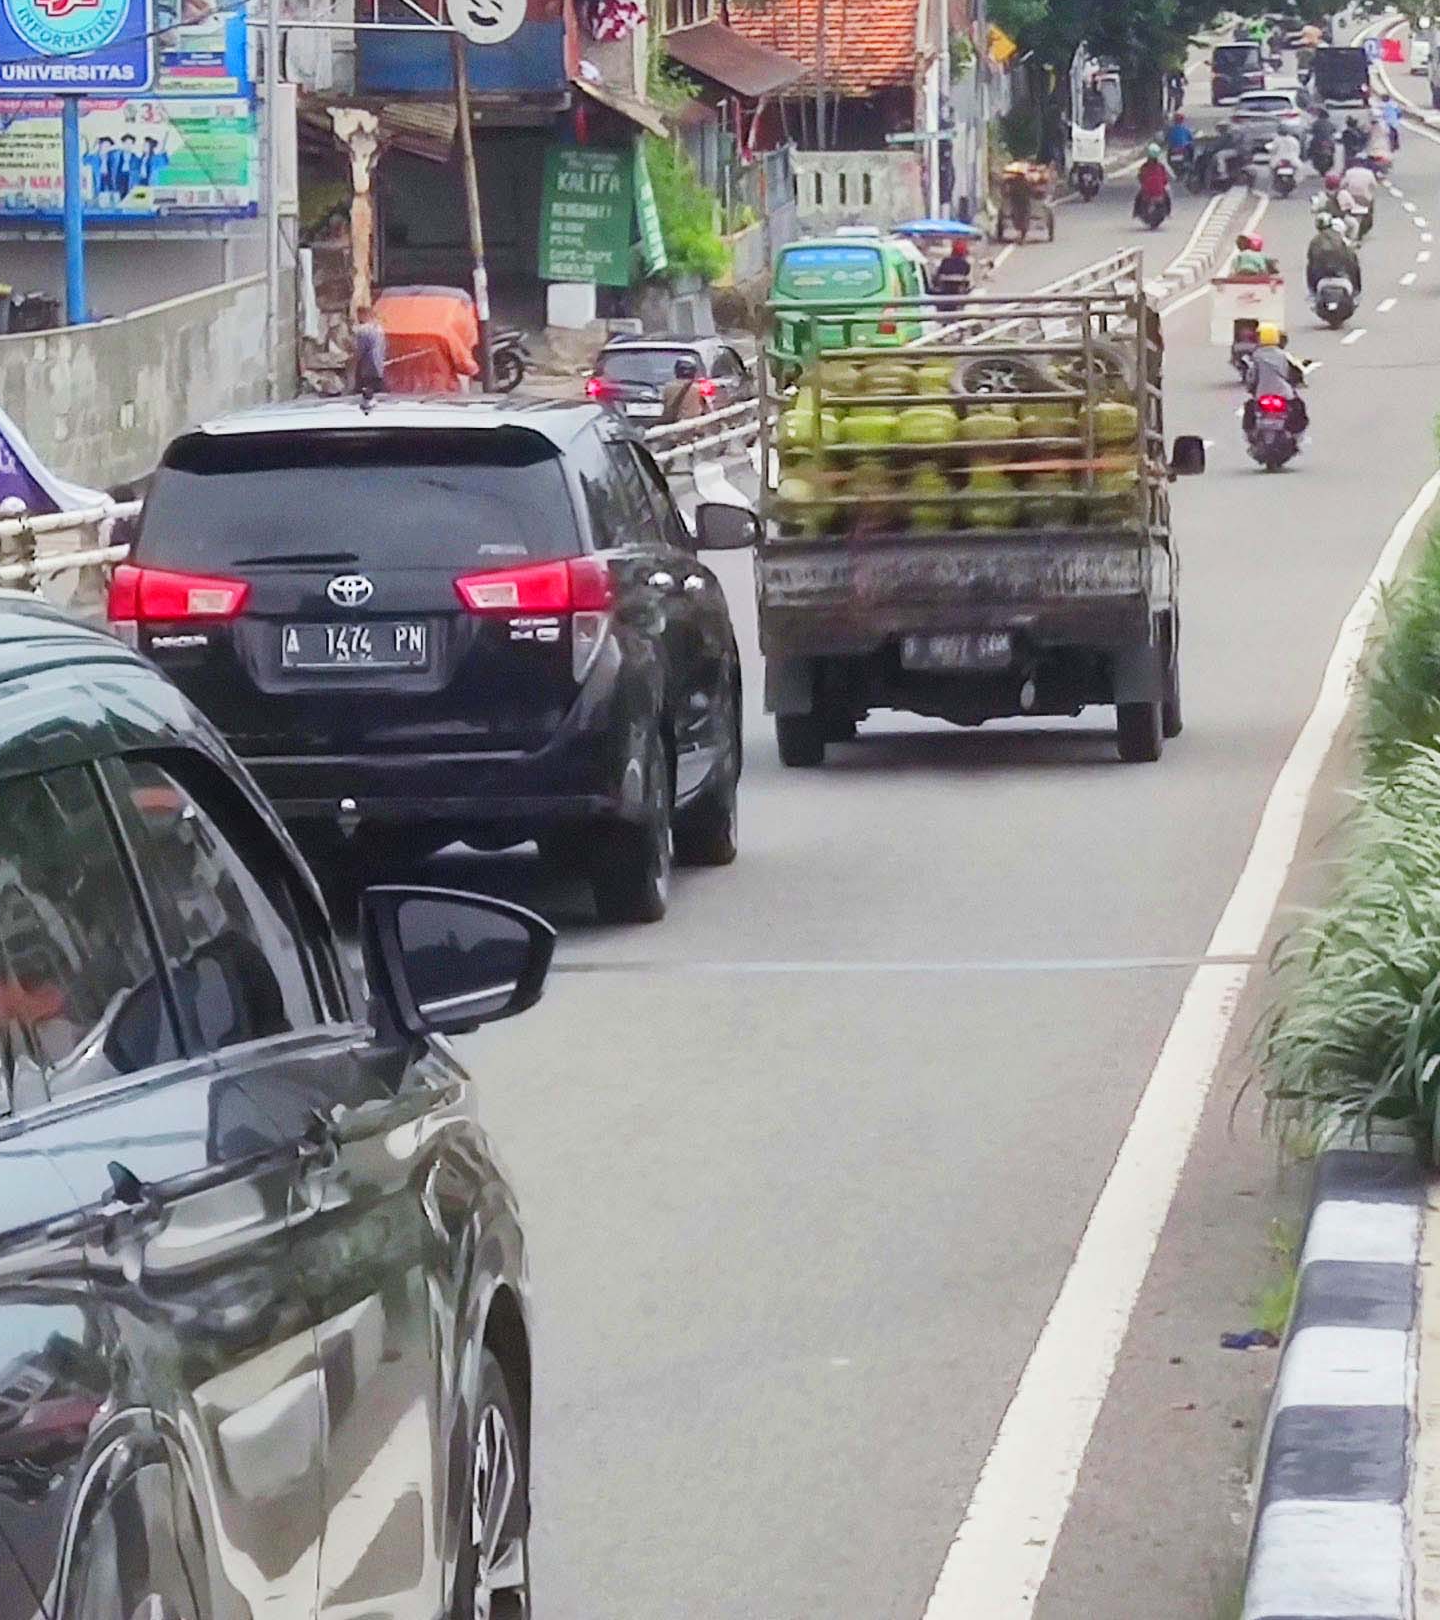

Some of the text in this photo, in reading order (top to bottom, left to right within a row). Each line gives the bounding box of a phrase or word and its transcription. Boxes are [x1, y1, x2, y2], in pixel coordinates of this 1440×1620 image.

[16, 9, 118, 48] INFORMATIKA
[1, 64, 135, 81] UNIVERSITAS
[286, 626, 422, 656] A 1474 PN
